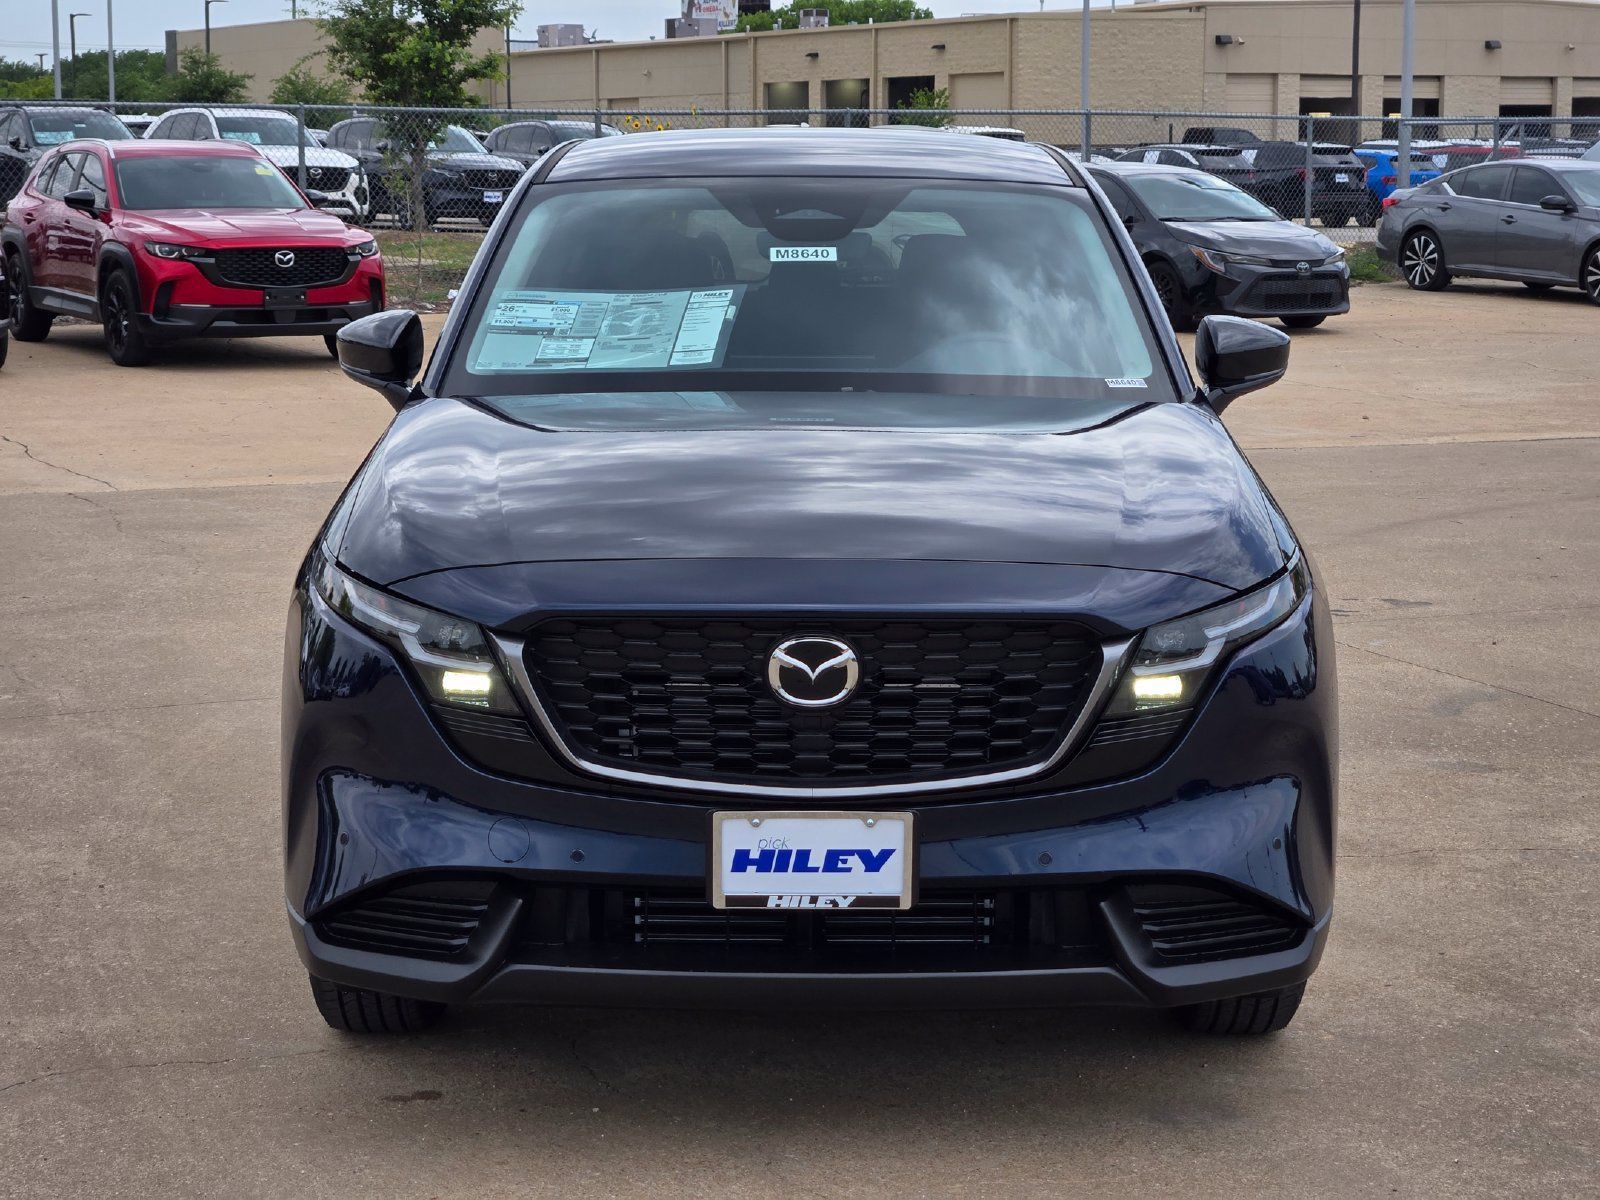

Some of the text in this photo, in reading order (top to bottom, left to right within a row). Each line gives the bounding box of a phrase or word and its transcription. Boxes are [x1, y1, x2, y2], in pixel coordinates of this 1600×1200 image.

[776, 249, 829, 258] M8640
[758, 837, 790, 850] pick
[731, 849, 896, 872] HILEY
[766, 896, 856, 908] HILEY
